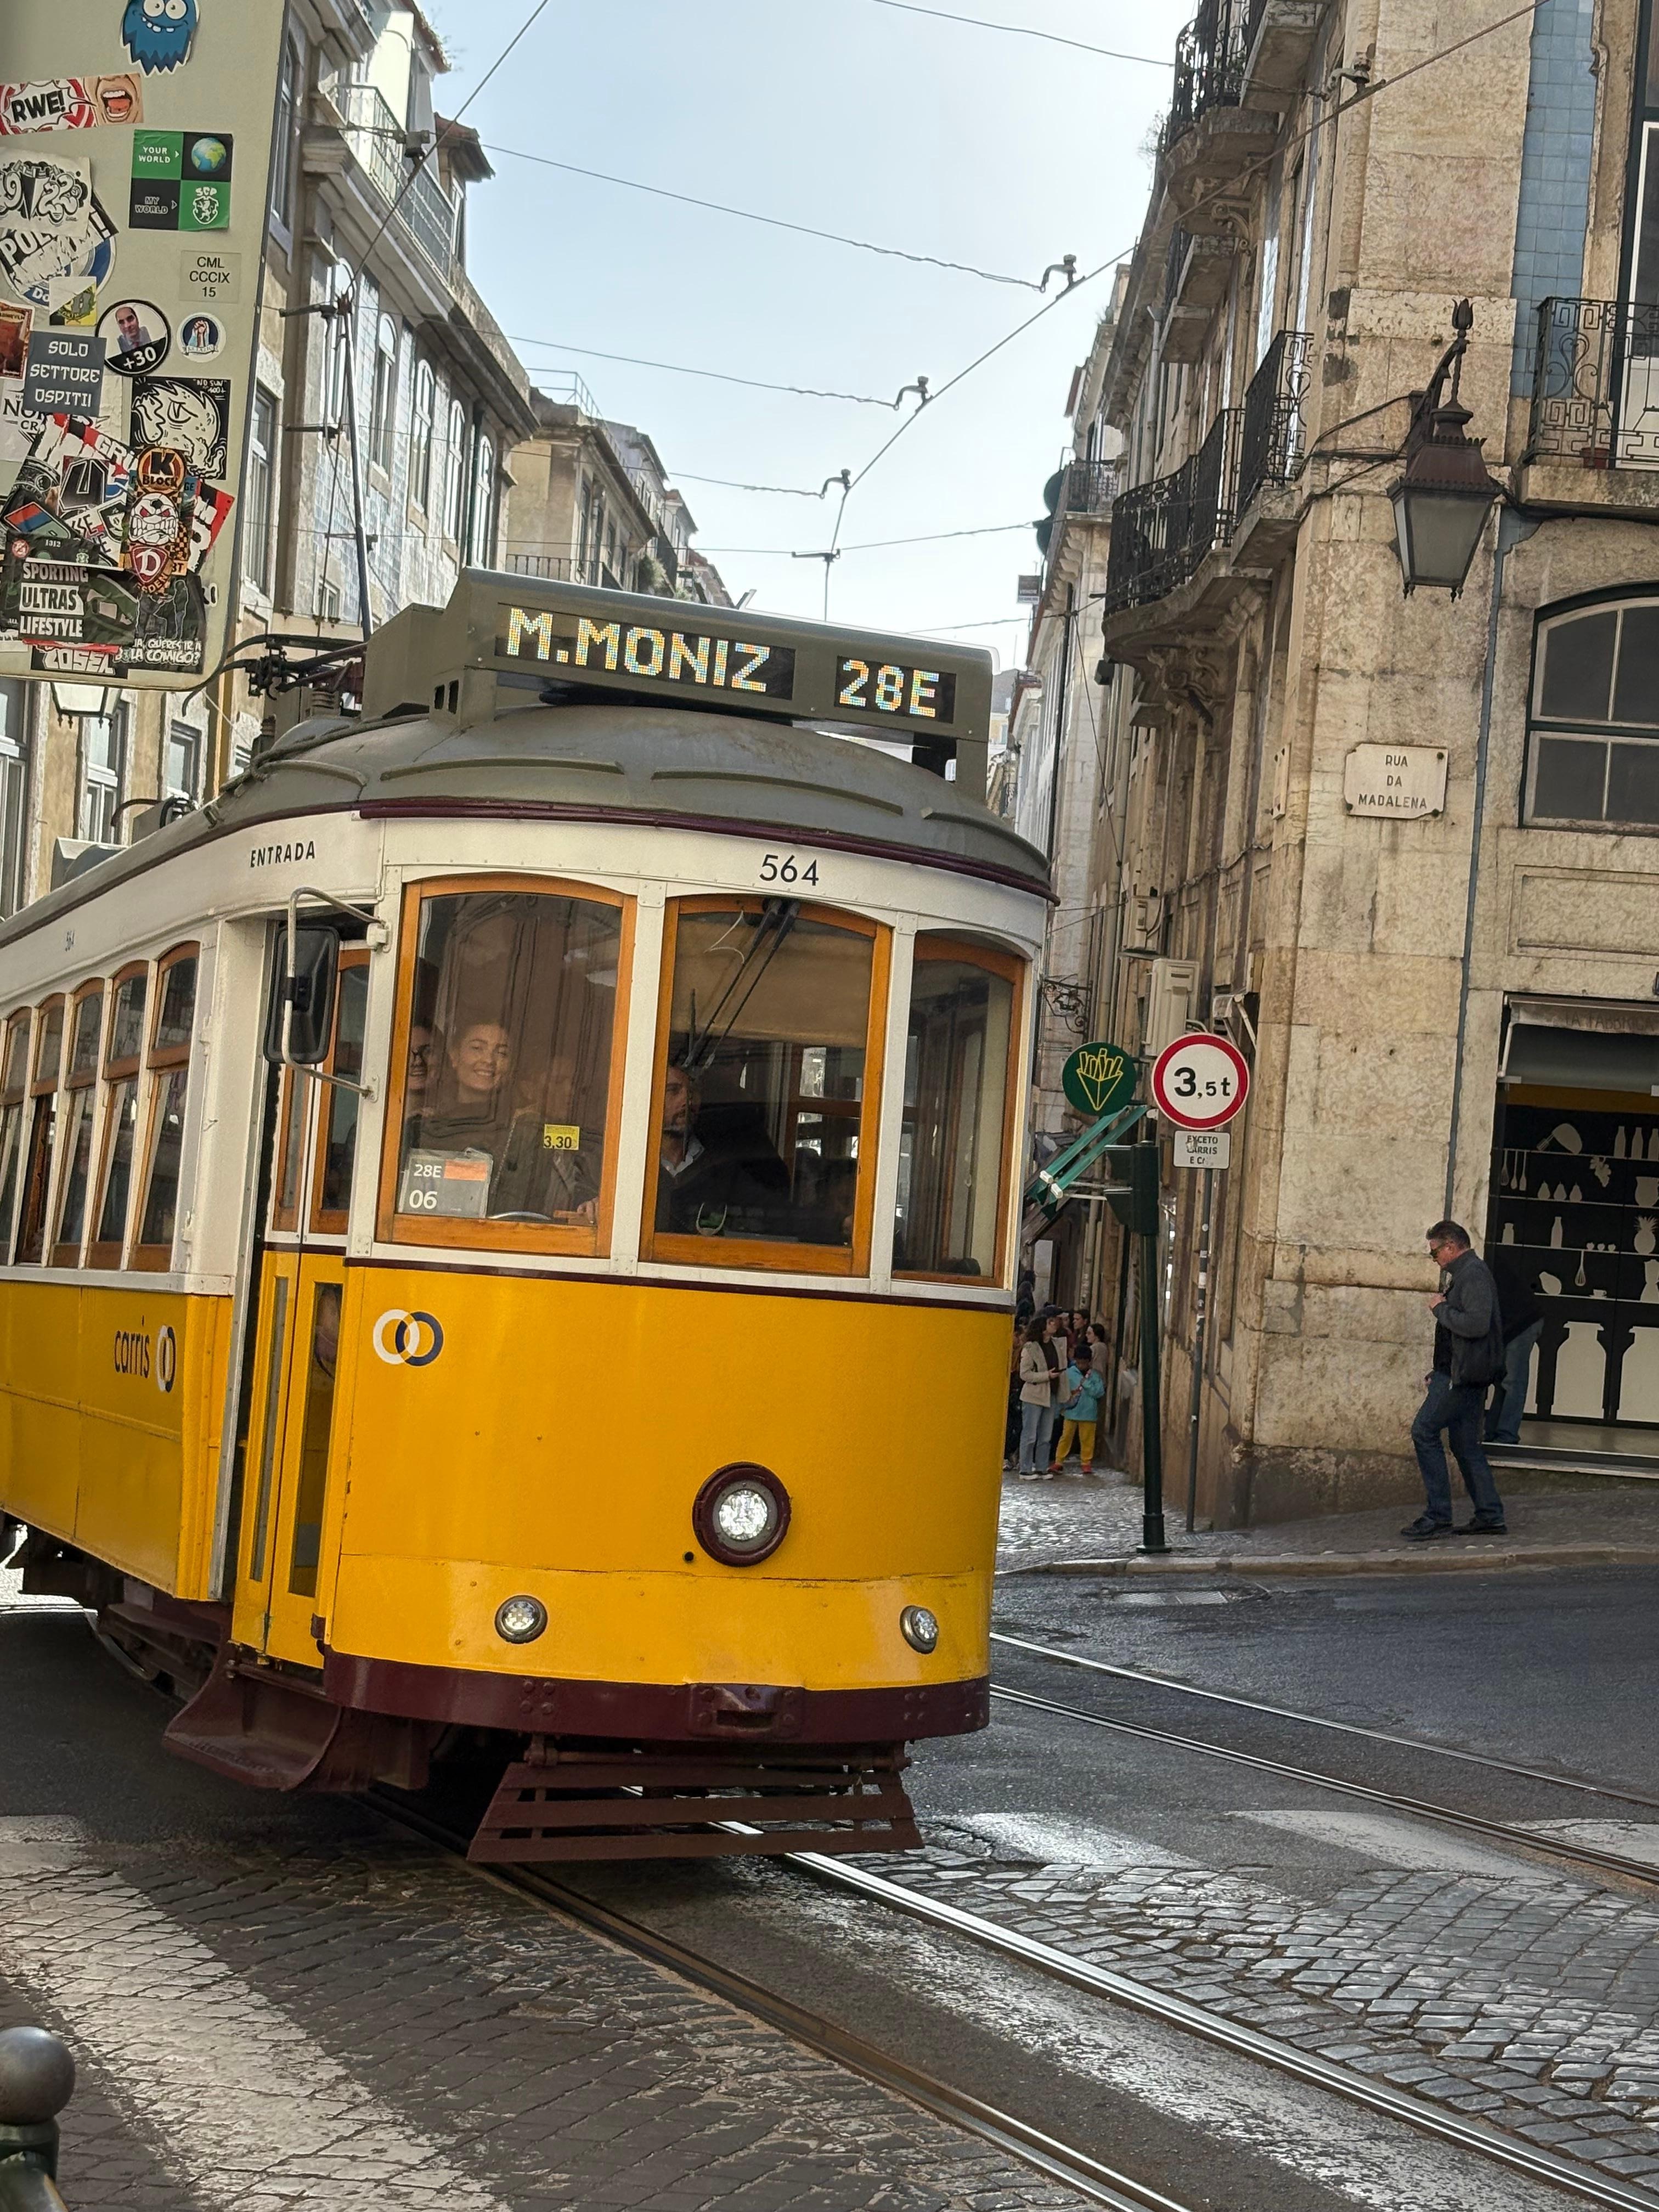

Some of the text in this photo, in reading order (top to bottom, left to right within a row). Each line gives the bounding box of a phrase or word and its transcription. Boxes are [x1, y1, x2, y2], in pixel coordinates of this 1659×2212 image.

[11, 89, 66, 123] RWE!
[138, 155, 171, 163] WORLD
[195, 187, 217, 196] SCP
[145, 196, 160, 205] MY
[135, 204, 169, 215] WORLD
[196, 256, 225, 268] CML
[189, 270, 230, 284] CCCIX
[201, 286, 217, 297] 15
[48, 341, 89, 357] SOLO
[123, 347, 156, 370] +30
[30, 364, 100, 383] SETTORE
[35, 388, 92, 408] OSPITI!
[150, 451, 176, 475] K
[142, 475, 178, 487] BLOCK
[23, 562, 89, 583] SPORTING
[22, 586, 77, 611] ULTRAS
[20, 616, 83, 637] LIFESTYLE
[506, 607, 940, 718] M.MONIZ 28E
[1385, 754, 1408, 767] RUA
[1386, 775, 1403, 787] DA
[1358, 793, 1427, 809] MADALENA
[250, 840, 316, 868] ENTRADA
[759, 854, 820, 886] 564
[413, 1164, 442, 1178] 28E
[409, 1189, 438, 1210] 06
[114, 1315, 150, 1379] carris
